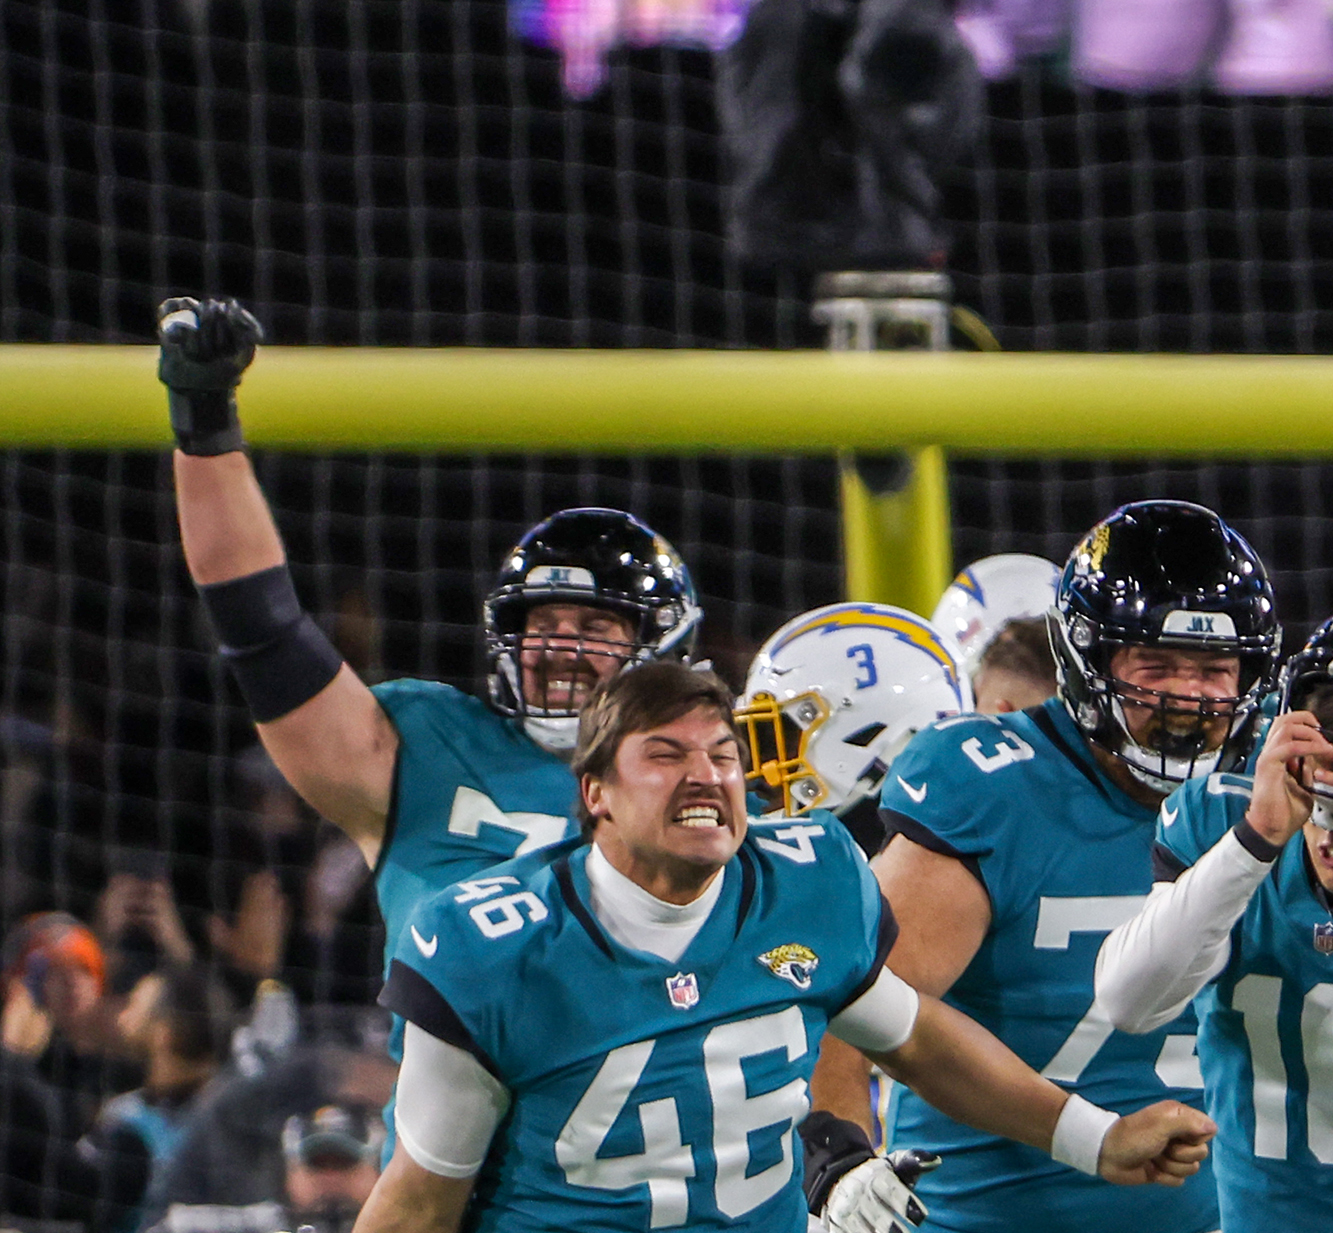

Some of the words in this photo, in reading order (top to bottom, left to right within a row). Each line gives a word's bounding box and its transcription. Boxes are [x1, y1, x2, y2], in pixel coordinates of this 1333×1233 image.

[847, 643, 877, 689] 3
[454, 876, 548, 938] 46
[555, 1005, 808, 1229] 46
